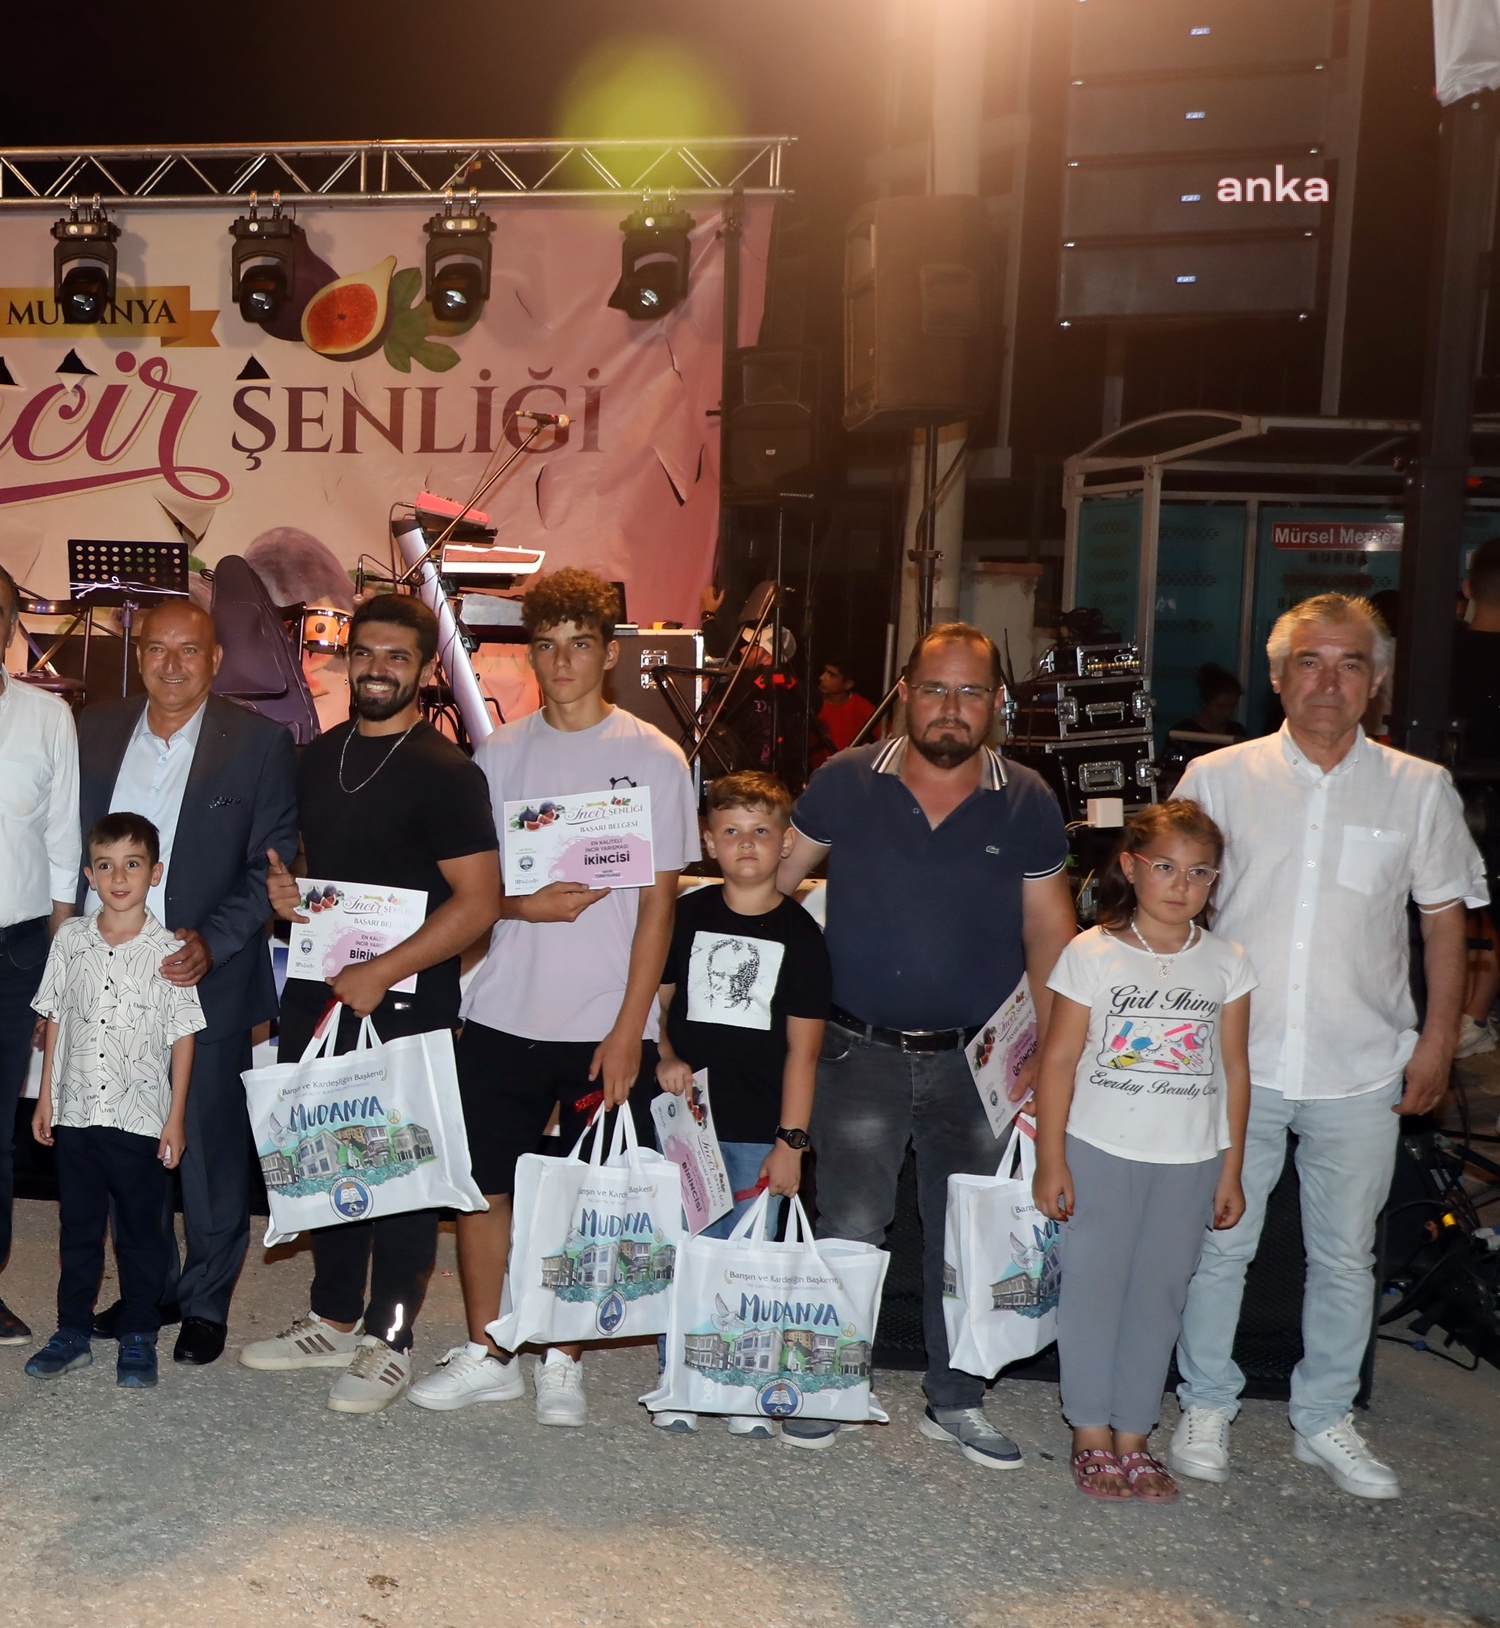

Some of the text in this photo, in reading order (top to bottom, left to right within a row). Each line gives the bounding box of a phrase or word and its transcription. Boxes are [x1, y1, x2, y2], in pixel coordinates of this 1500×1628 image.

[7, 300, 176, 325] MUNYA
[232, 366, 607, 470] ŞENLİĞİ
[1275, 528, 1333, 544] Mürsel
[585, 851, 630, 865] İKİNCİSİ
[350, 948, 378, 960] BİRİN
[1110, 985, 1158, 1014] Girl
[1012, 1041, 1037, 1076] ÜÇÜNCÜS
[313, 1077, 353, 1088] Kardeşliğin
[354, 1070, 384, 1081] Başkenti
[1090, 1070, 1144, 1095] Everday
[1147, 1079, 1200, 1100] Beauty
[290, 1096, 384, 1132] MUDANYA
[681, 1162, 702, 1213] BİRİNCİSİ
[729, 1271, 755, 1280] Barışın
[740, 1293, 839, 1326] MUDANYA
